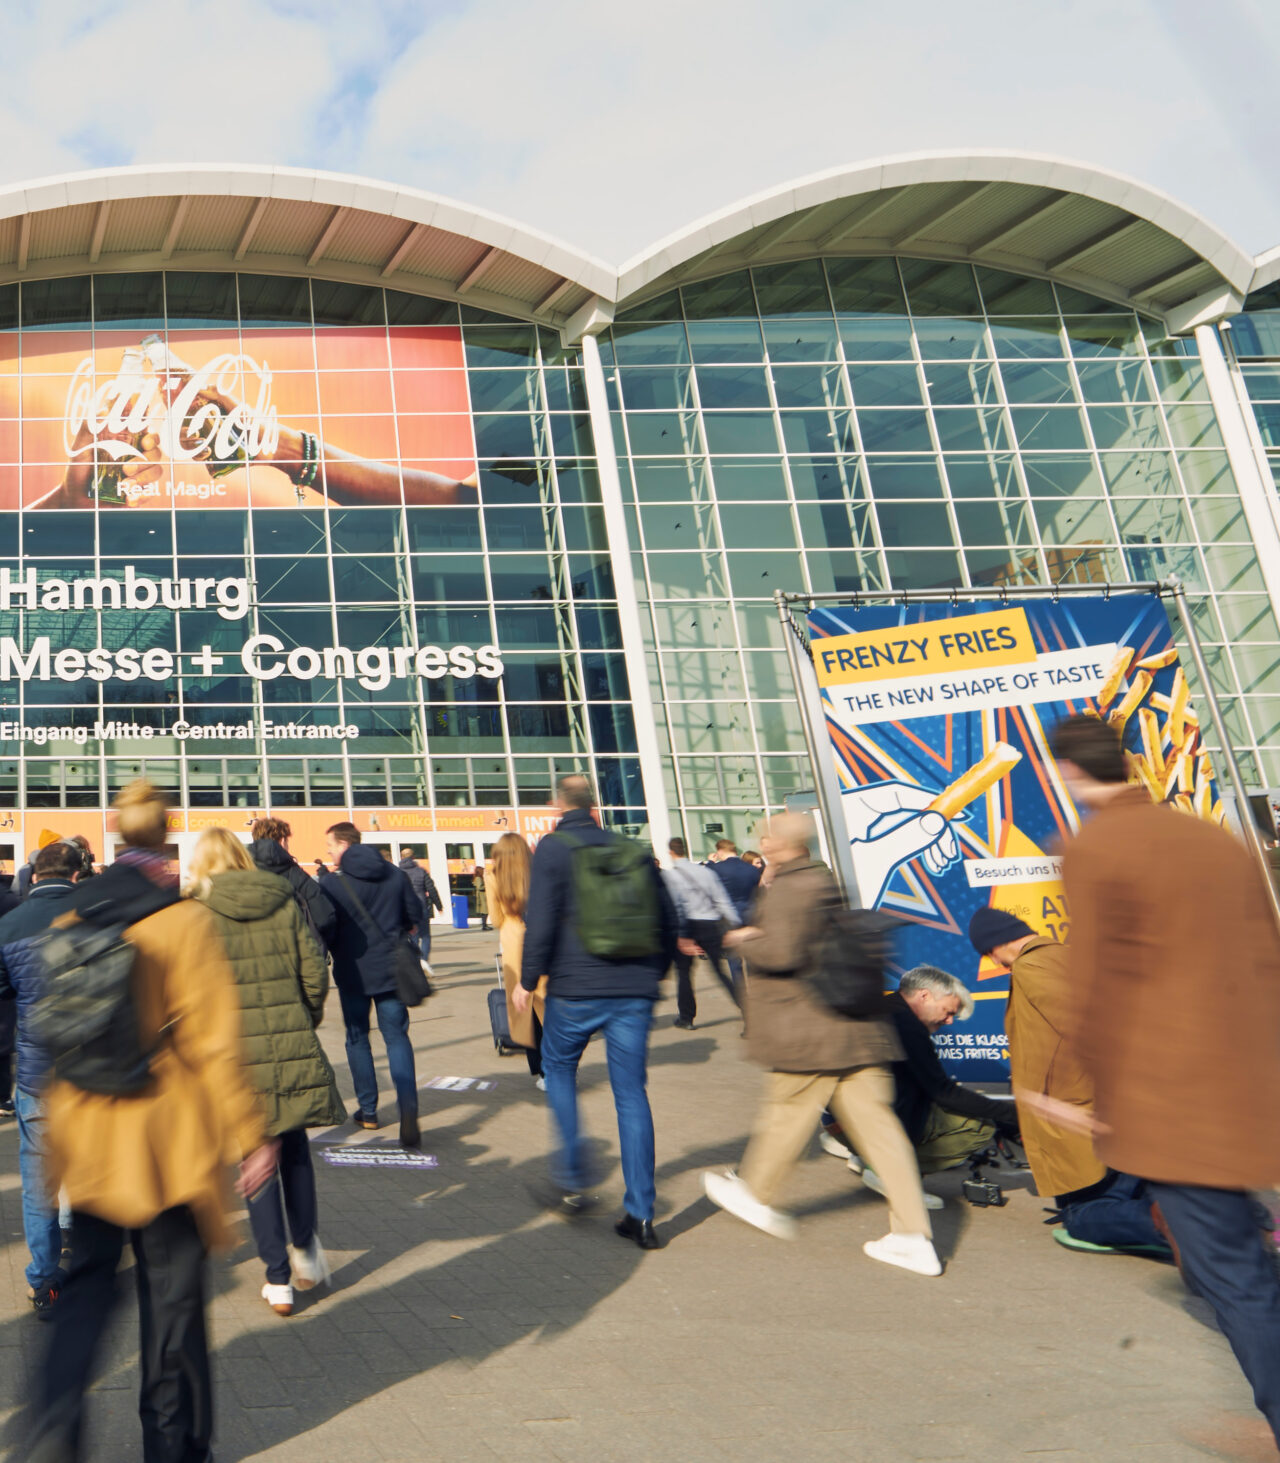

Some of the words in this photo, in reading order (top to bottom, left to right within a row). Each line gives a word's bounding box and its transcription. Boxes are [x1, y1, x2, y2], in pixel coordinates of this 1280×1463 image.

[64, 353, 280, 461] Coca-Cola
[117, 481, 160, 497] Real
[166, 480, 227, 499] Magic
[0, 565, 251, 620] Hamburg
[821, 638, 929, 673] FRENZY
[938, 626, 1018, 658] FRIES
[0, 637, 174, 682] Messe
[241, 633, 504, 691] Congress
[844, 694, 883, 713] THE
[887, 688, 935, 707] NEW
[942, 678, 1009, 700] SHAPE
[1012, 672, 1039, 691] OF
[1043, 663, 1104, 685] TASTE
[0, 721, 88, 745] Eingang
[94, 721, 154, 740] Mitte
[172, 720, 254, 740] Central
[261, 720, 360, 740] Entrance
[166, 815, 229, 828] elcome
[387, 813, 485, 828] Willkommen!
[974, 864, 1022, 879] Besuch
[1026, 865, 1050, 875] uns
[955, 1034, 975, 1046] DIE
[975, 1034, 1011, 1046] KLASS
[935, 1048, 964, 1060] MES
[964, 1048, 1001, 1060] FRITES
